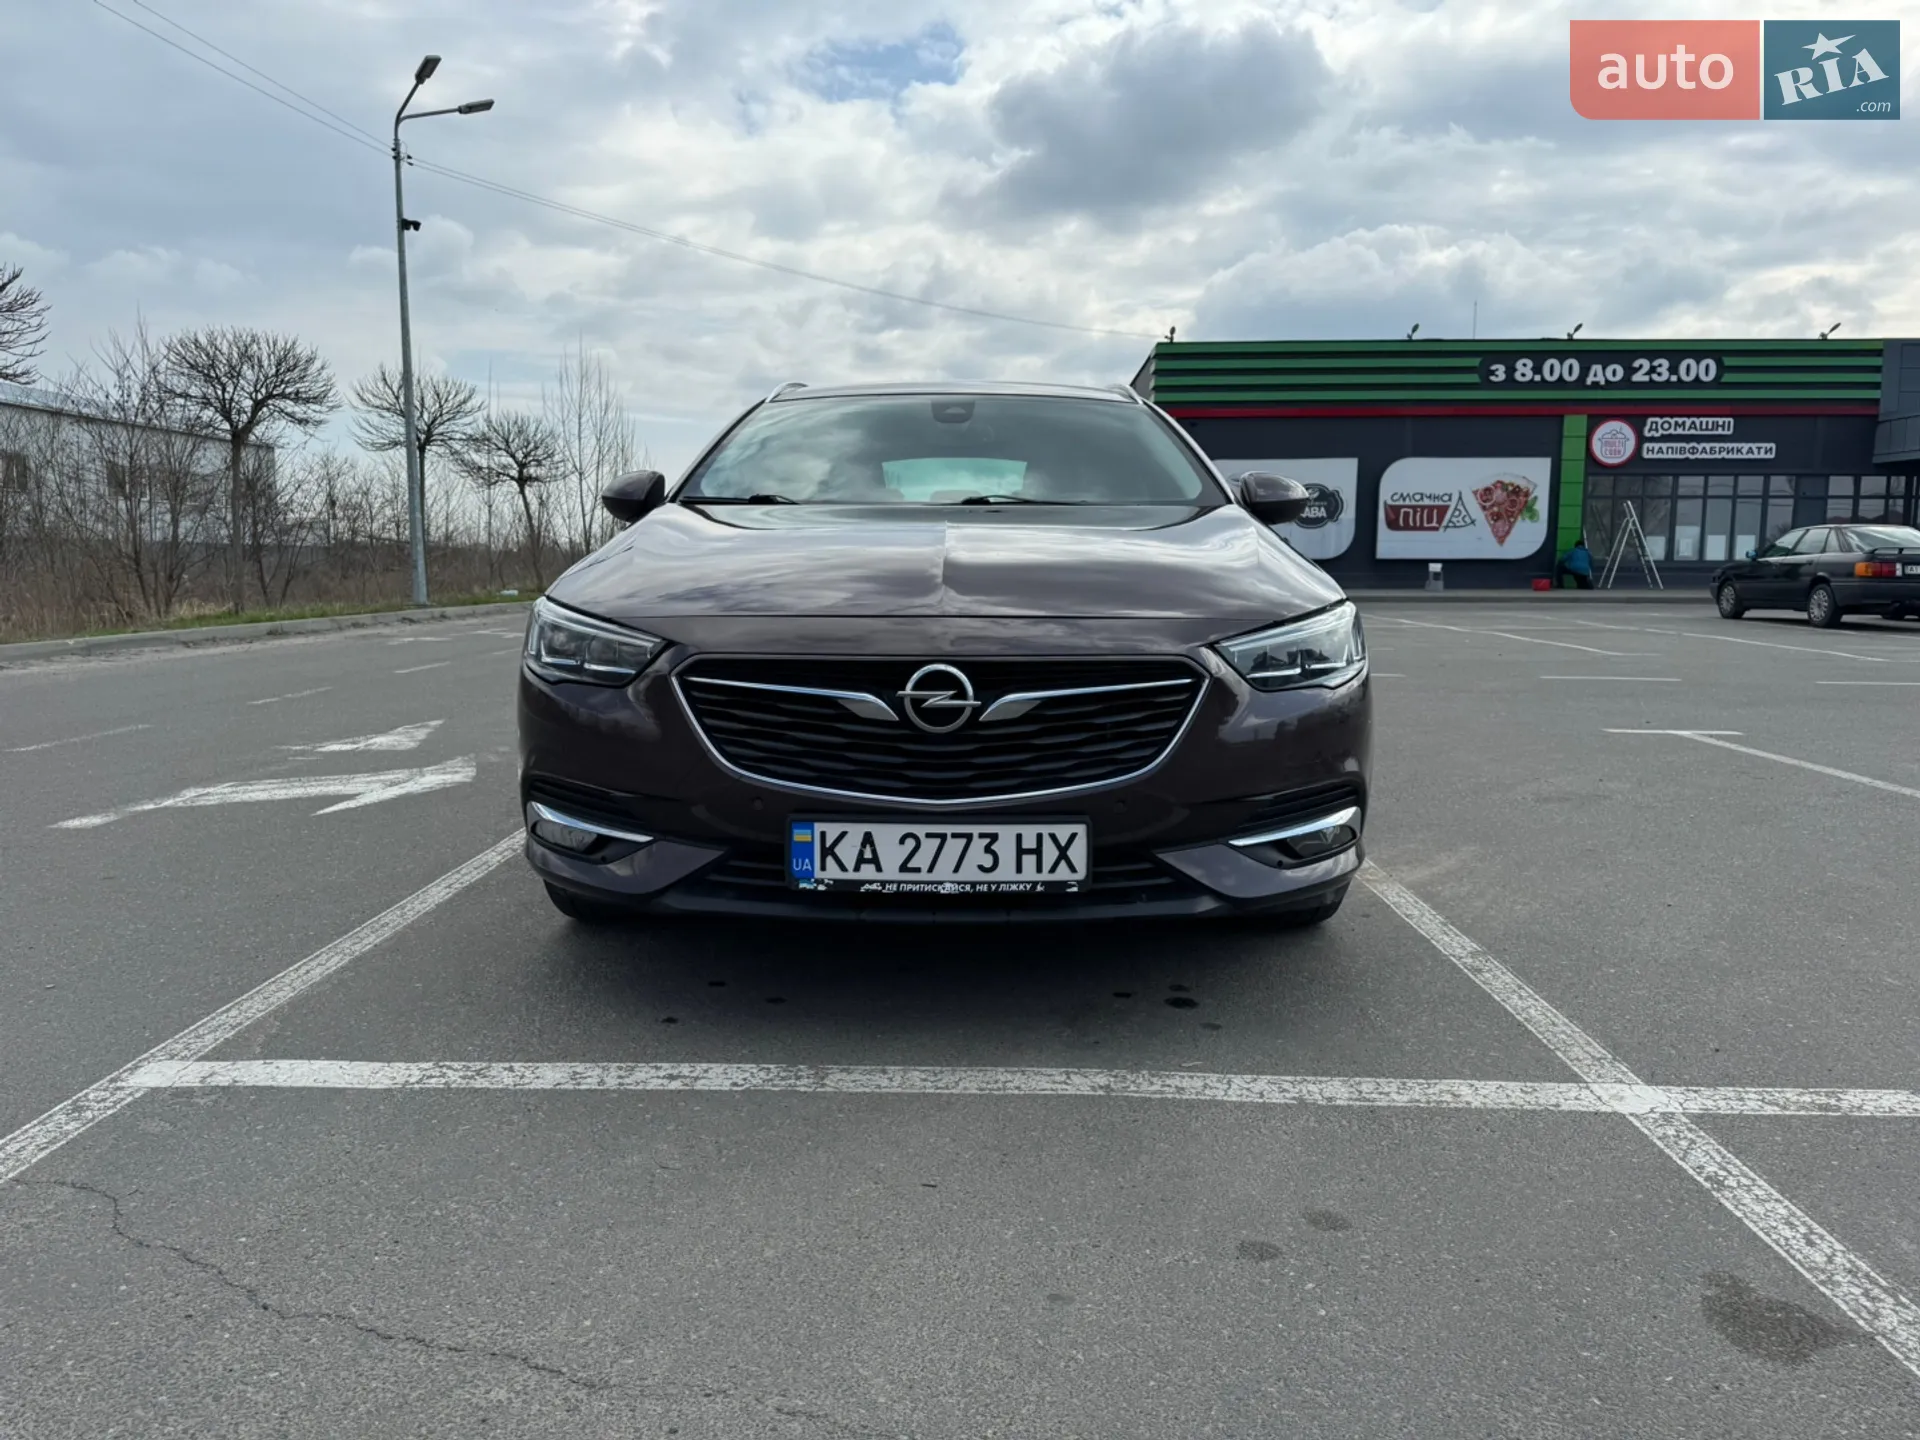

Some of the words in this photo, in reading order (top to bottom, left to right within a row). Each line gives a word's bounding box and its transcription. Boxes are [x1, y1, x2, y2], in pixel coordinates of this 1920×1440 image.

[1489, 363, 1507, 382] з
[1513, 358, 1580, 382] 8.00
[1586, 363, 1625, 386] до
[1631, 358, 1717, 382] 23.00
[1646, 419, 1732, 435] ДОМАШНІ
[1645, 444, 1774, 457] НАПІВФАБРИКАТИ
[819, 830, 883, 873] KA
[898, 832, 1000, 874] 2773
[1015, 832, 1079, 874] HX
[793, 858, 812, 871] UA
[976, 884, 988, 892] НЕ
[990, 884, 999, 892] У
[999, 883, 1032, 892] ЛІЖКУ
